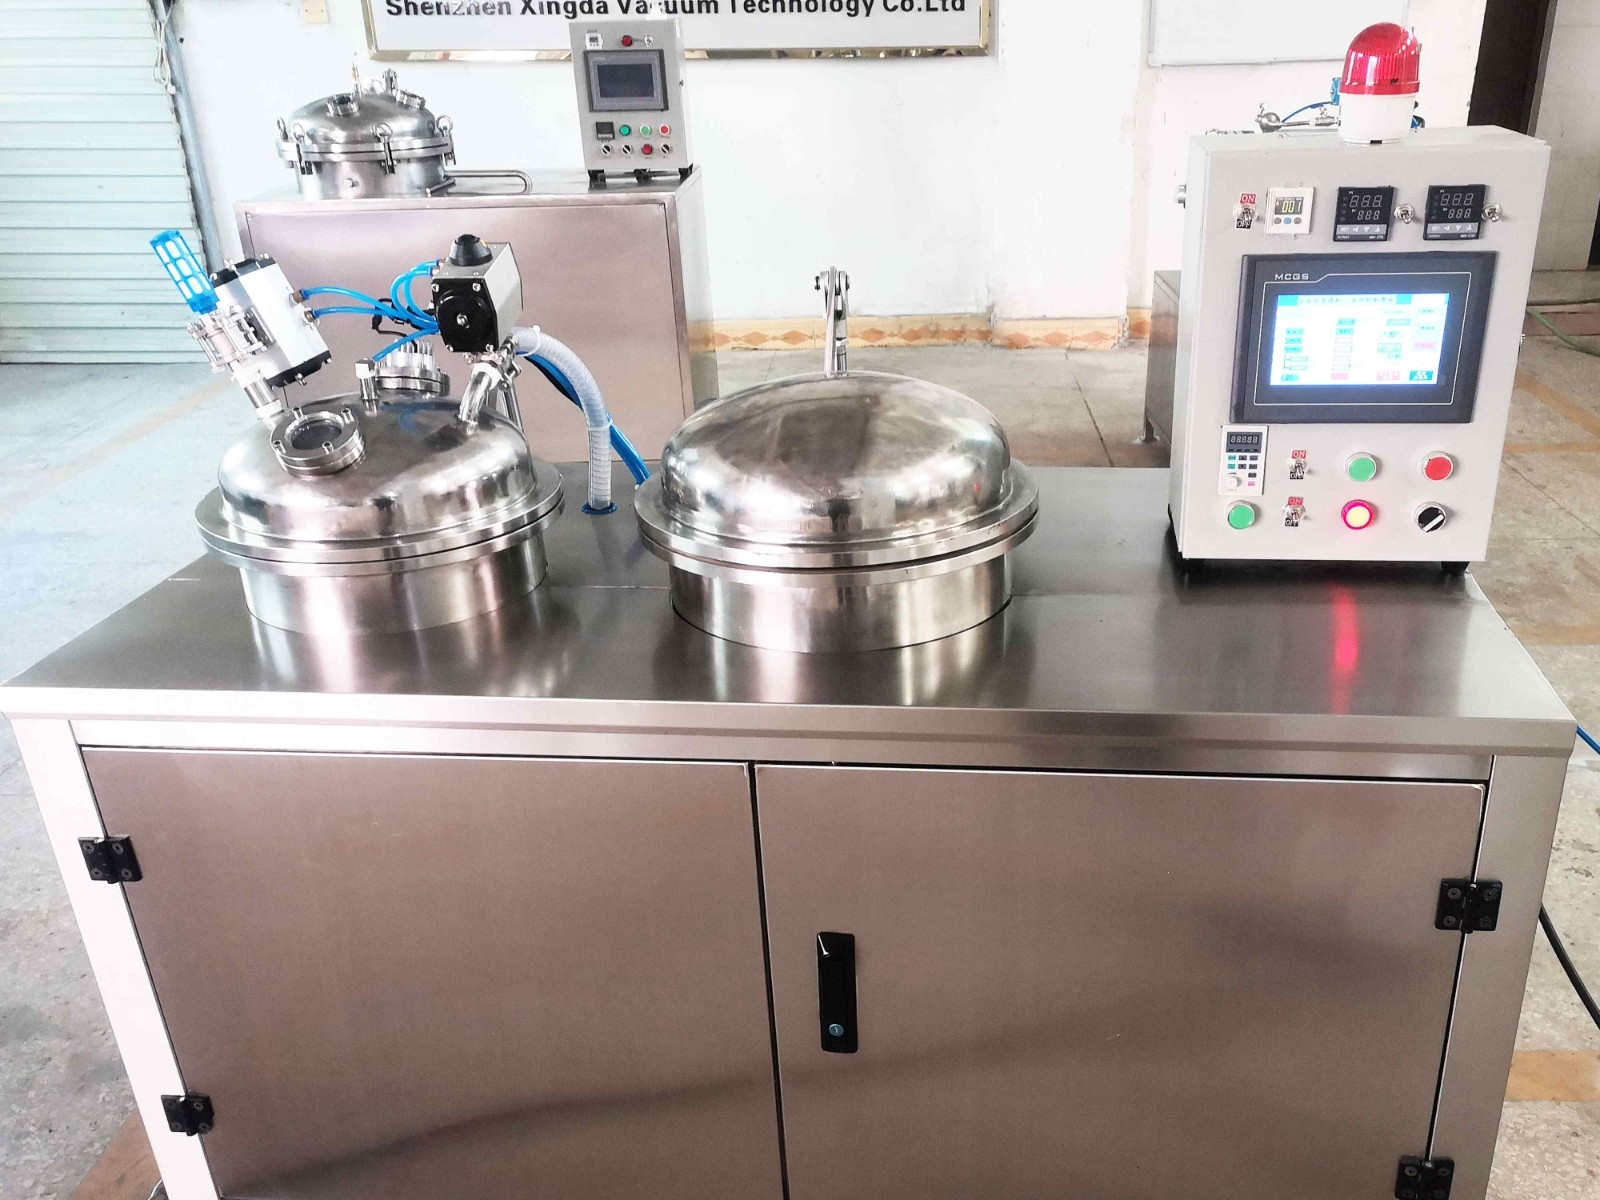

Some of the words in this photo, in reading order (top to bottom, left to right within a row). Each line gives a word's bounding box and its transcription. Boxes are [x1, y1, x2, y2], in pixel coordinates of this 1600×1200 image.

[385, 0, 512, 16] Shenzhen
[520, 0, 609, 19] Xingda
[616, 0, 719, 14] Vauum
[1241, 194, 1255, 203] ON
[1293, 450, 1306, 458] ON
